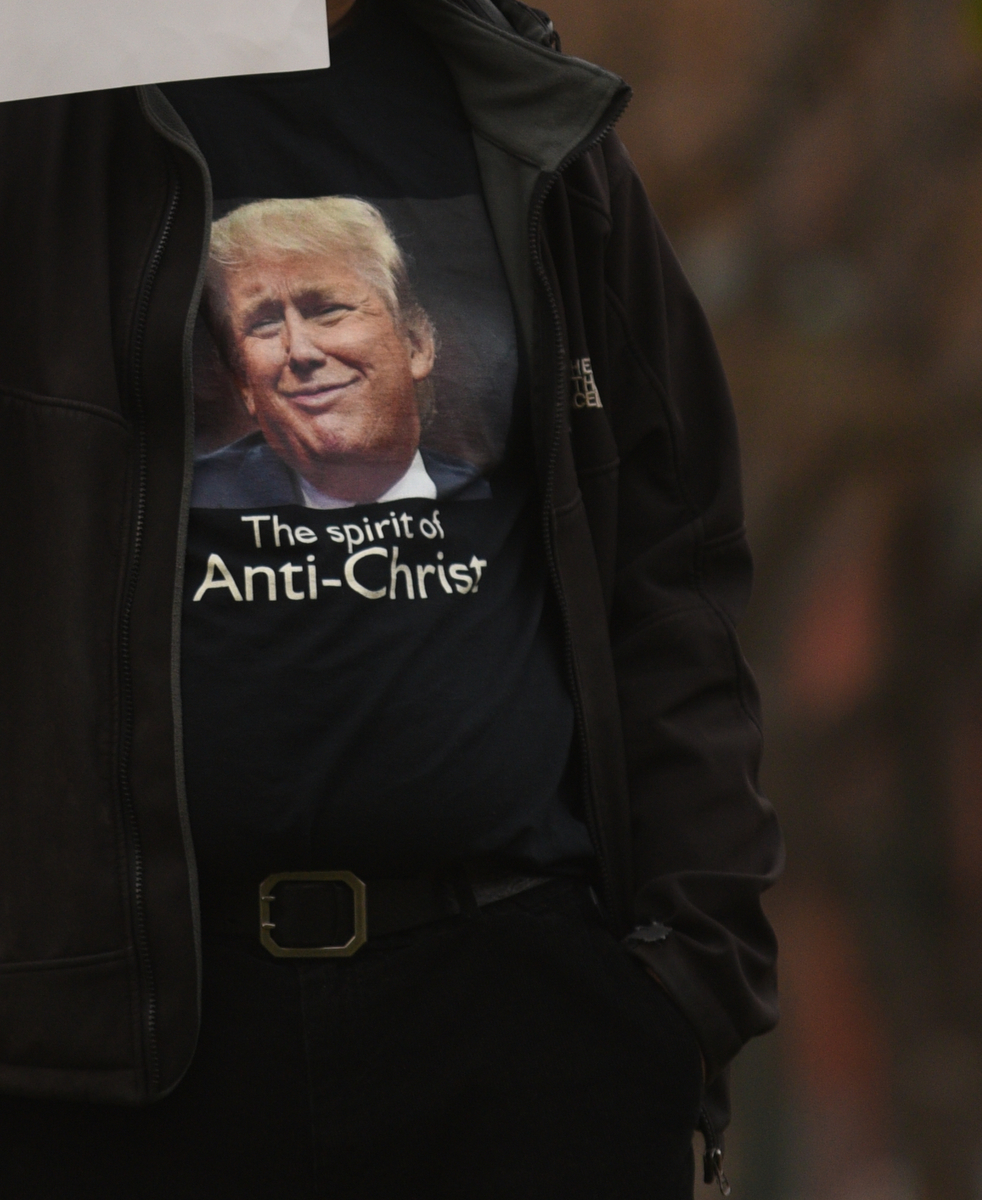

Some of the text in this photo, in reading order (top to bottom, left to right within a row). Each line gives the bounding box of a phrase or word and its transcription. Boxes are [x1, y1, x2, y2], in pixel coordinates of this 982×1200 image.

[241, 509, 445, 554] The spirit of
[192, 546, 487, 602] Anti-Christ
